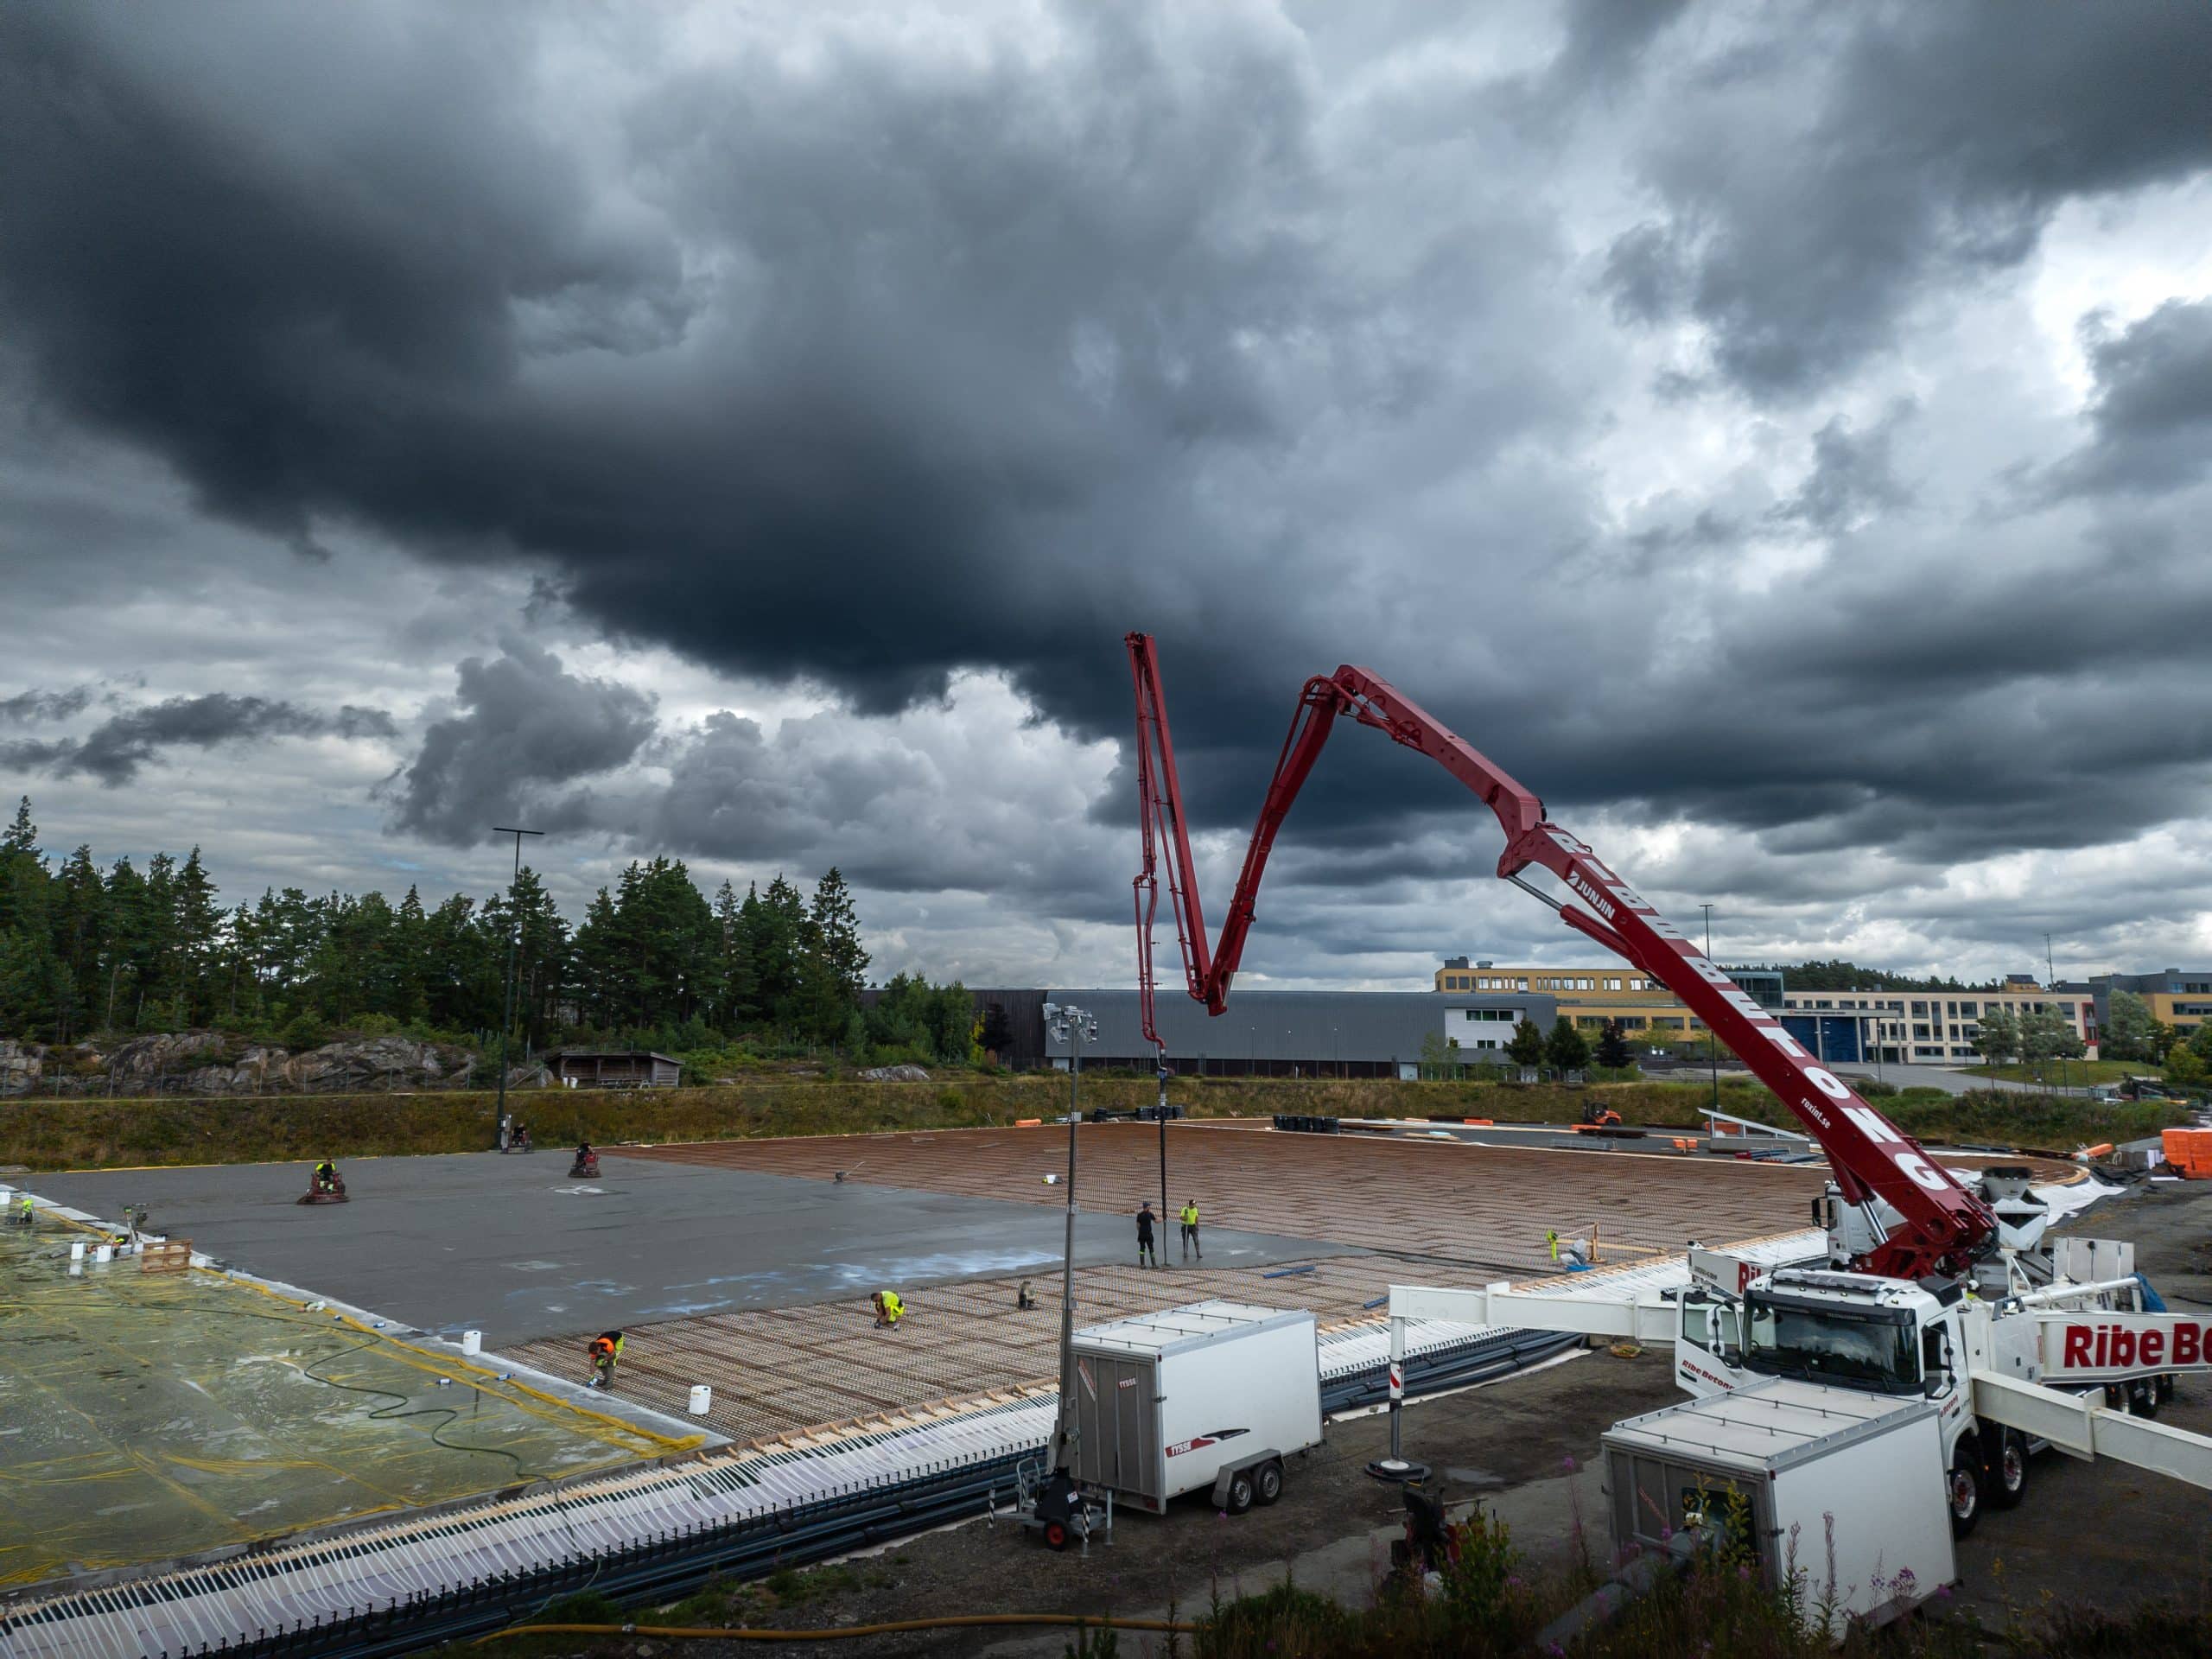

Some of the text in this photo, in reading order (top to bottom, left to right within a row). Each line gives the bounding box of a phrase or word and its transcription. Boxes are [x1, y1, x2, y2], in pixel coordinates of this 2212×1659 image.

[1577, 880, 1616, 920] JUNJIN
[1547, 831, 1949, 1191] RIBE BETONG
[1801, 1097, 1831, 1129] roxint.se
[2063, 1325, 2164, 1368] Ribe
[1681, 1359, 1701, 1375] Ribe
